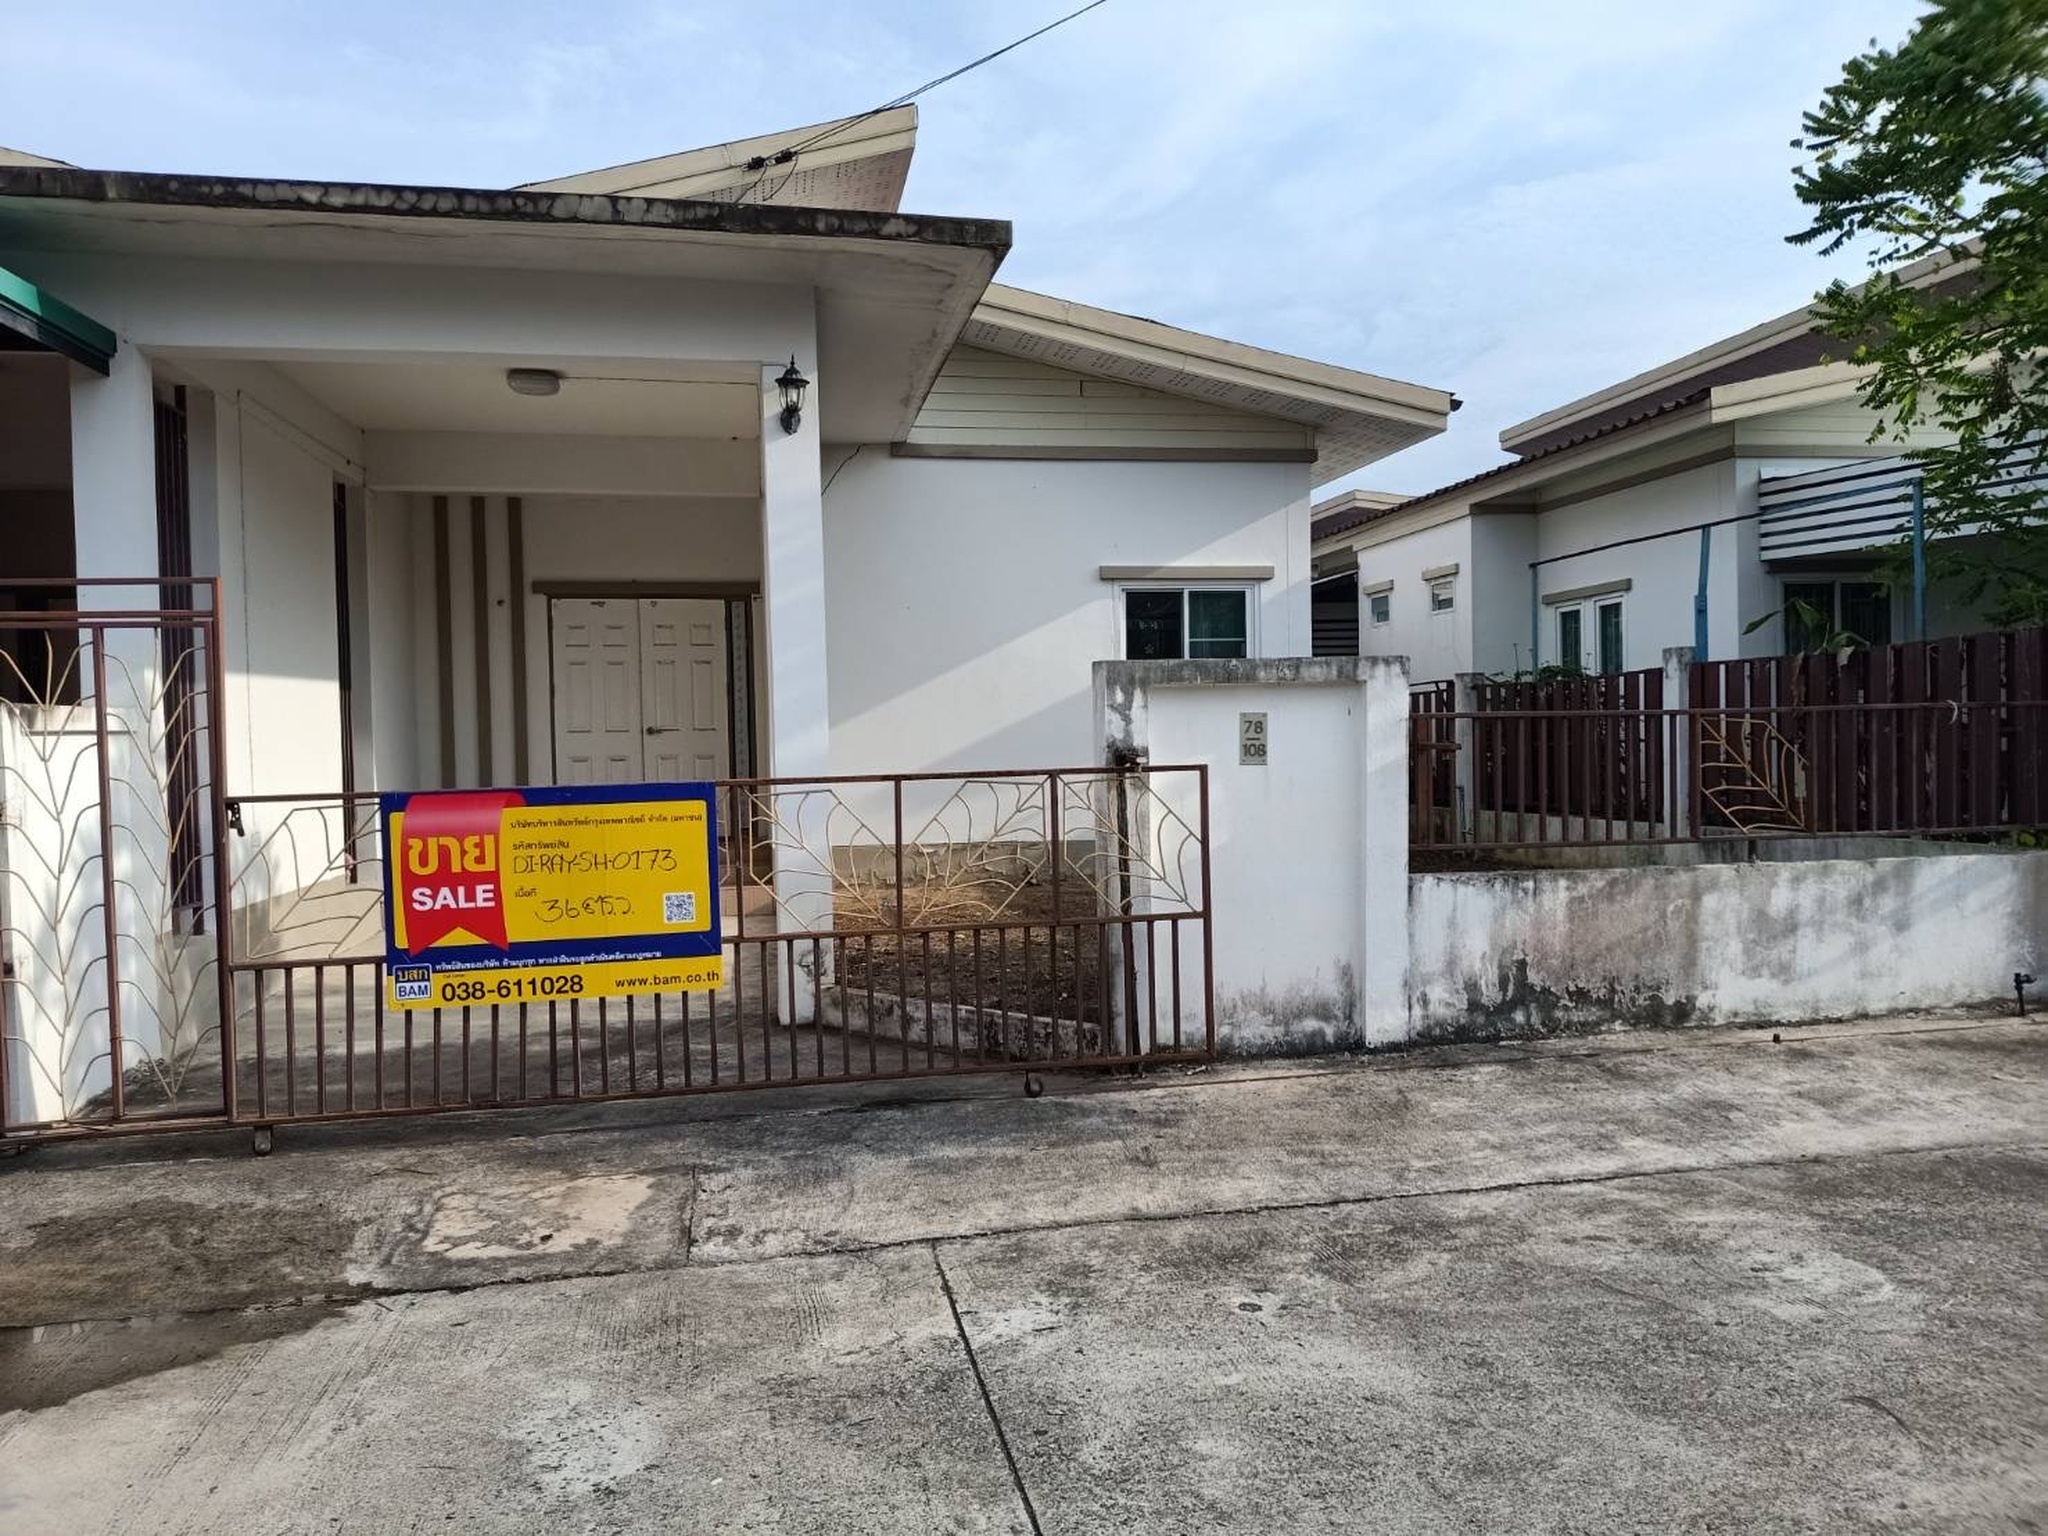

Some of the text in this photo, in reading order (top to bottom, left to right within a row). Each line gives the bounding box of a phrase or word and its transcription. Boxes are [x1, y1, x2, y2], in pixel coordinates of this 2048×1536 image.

[1243, 720, 1264, 734] 78
[1242, 743, 1266, 757] 108
[408, 834, 496, 876] ขาย
[411, 884, 496, 912] SALE
[396, 968, 428, 982] บสก
[398, 984, 429, 998] BAM
[442, 970, 720, 1003] 038-611028 www.bam.co.th
